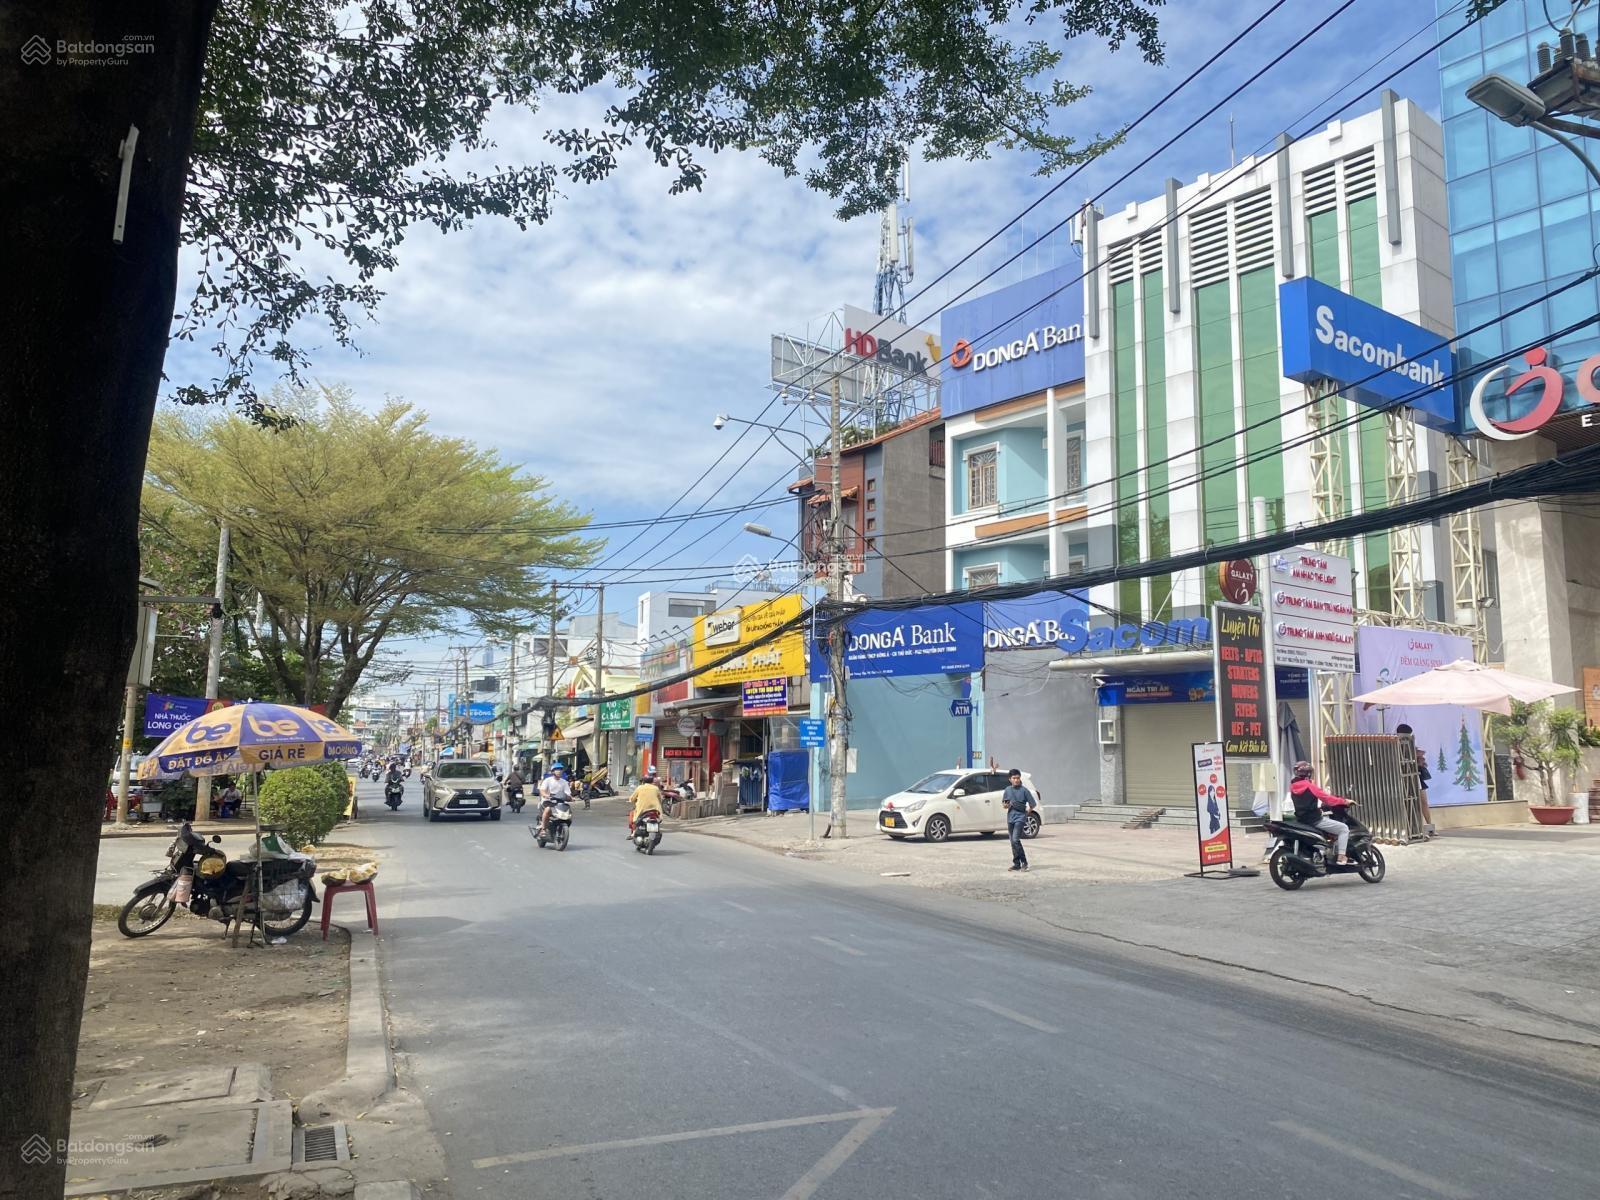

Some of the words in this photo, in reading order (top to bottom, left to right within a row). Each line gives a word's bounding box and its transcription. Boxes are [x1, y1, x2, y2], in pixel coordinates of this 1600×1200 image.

[1042, 321, 1084, 350] Ban
[1315, 304, 1446, 392] Sacombank
[1230, 569, 1254, 581] GALAXY
[712, 620, 735, 634] weber
[911, 621, 957, 646] Bank
[1247, 615, 1260, 638] Thi
[1335, 634, 1354, 644] GALAXY
[1414, 641, 1434, 651] GALAXY
[170, 713, 191, 721] THUỐC
[954, 706, 970, 714] ATM
[147, 721, 172, 730] LONG
[185, 722, 233, 745] be
[246, 713, 300, 737] be
[168, 756, 193, 771] ĐẶT
[194, 751, 213, 766] ĐỒ
[258, 746, 284, 761] GIÁ
[287, 744, 306, 759] RẺ
